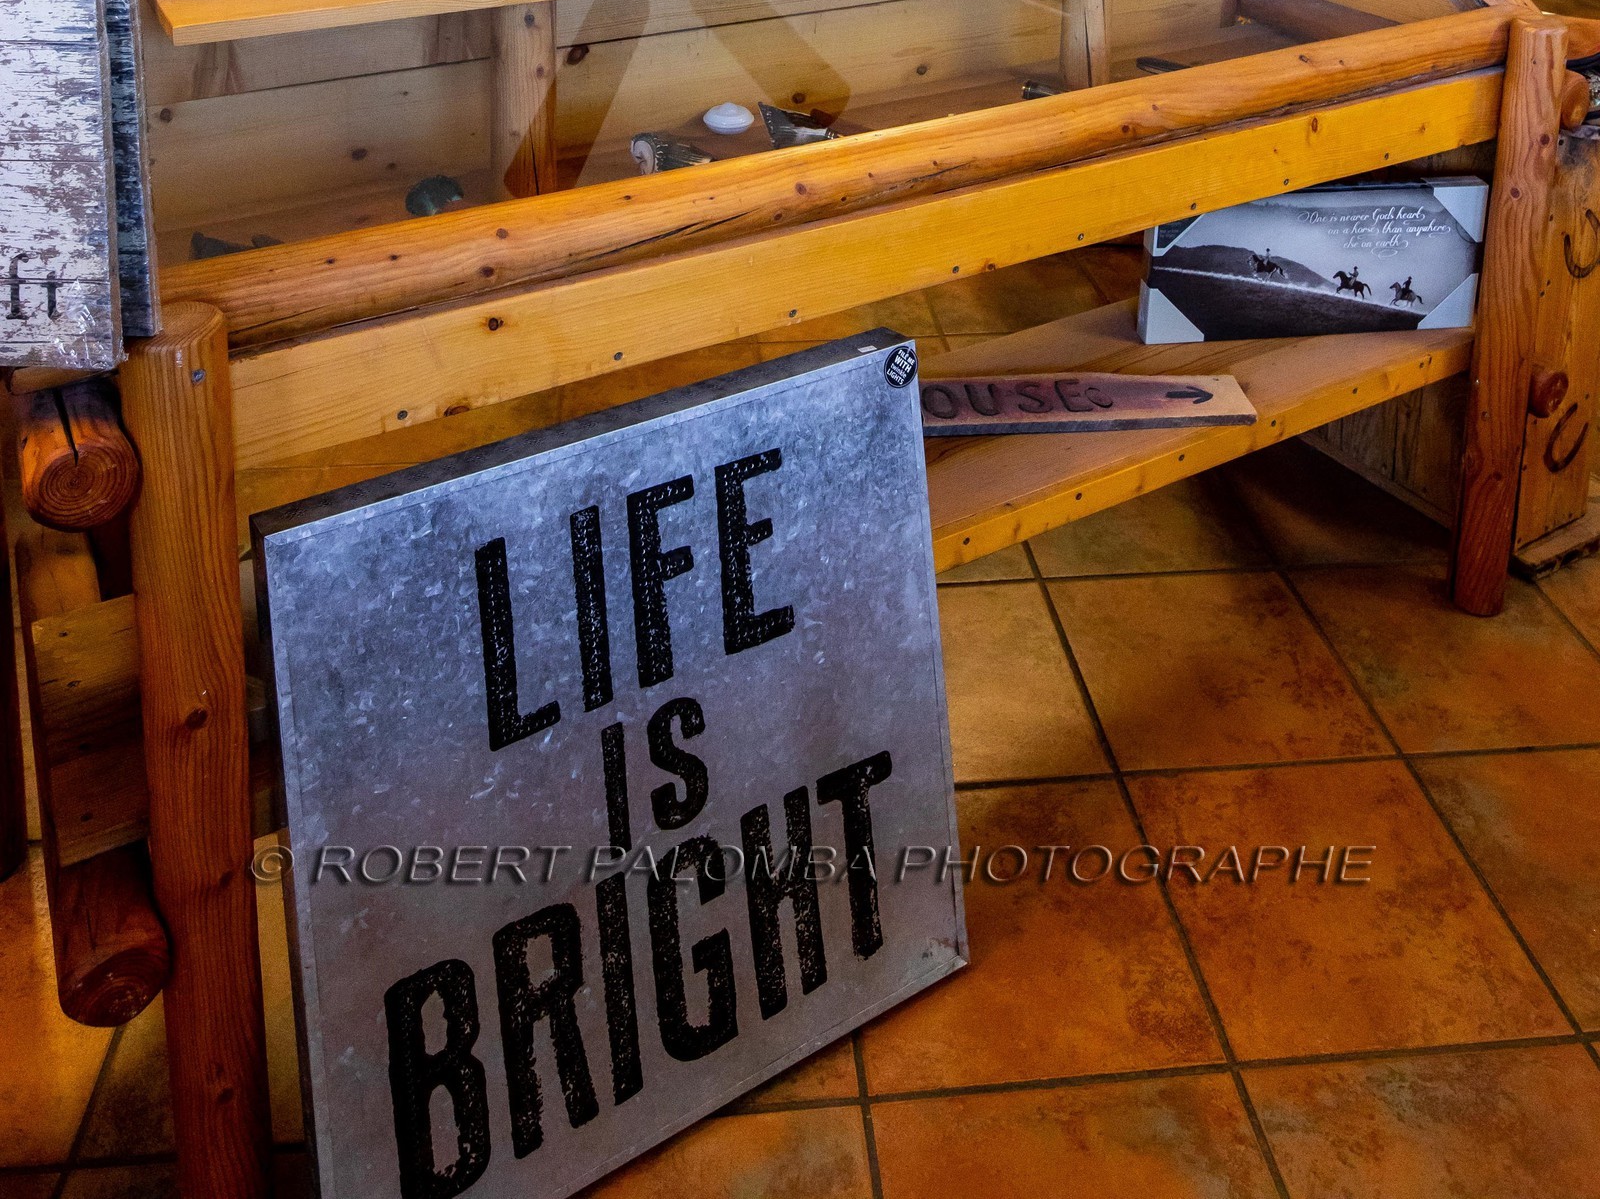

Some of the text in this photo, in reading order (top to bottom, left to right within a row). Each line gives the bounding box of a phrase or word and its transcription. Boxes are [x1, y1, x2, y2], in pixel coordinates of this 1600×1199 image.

[1302, 211, 1327, 224] One
[1330, 212, 1337, 222] is
[1340, 213, 1370, 221] nearer
[1382, 221, 1402, 234] than
[1406, 219, 1450, 237] anywhere
[1361, 240, 1372, 248] on
[1375, 234, 1408, 249] earth
[894, 355, 912, 373] WITH
[886, 368, 904, 385] LIGHTS
[475, 448, 795, 752] LIFE
[600, 697, 706, 851] IS
[384, 751, 892, 1199] BRIGHT
